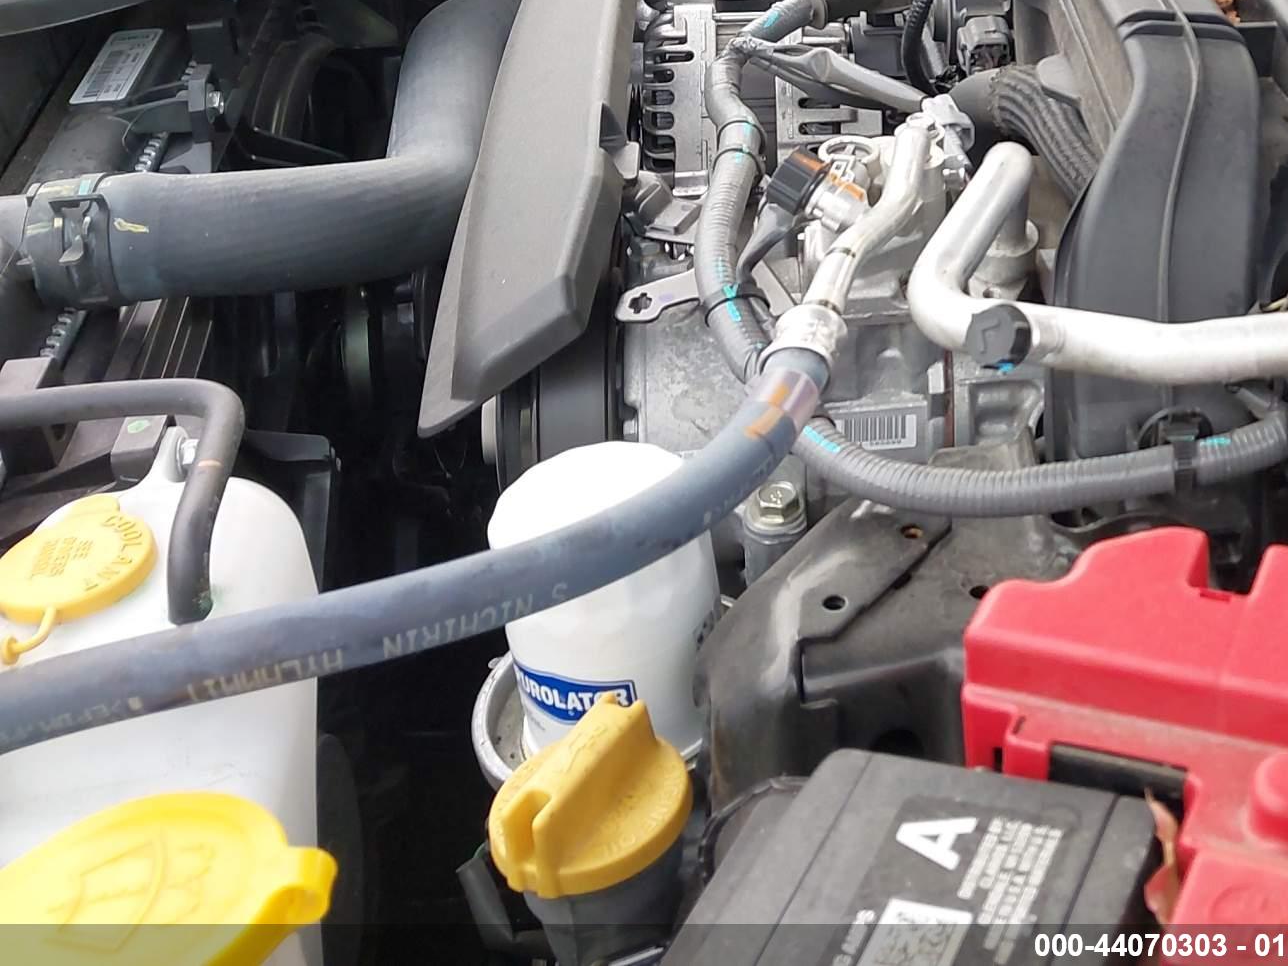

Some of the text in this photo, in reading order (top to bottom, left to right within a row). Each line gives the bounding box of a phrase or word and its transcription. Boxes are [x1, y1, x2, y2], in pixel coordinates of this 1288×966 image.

[83, 515, 142, 592] COOLANT
[382, 593, 534, 661] NICHIRIN
[896, 817, 978, 870] A
